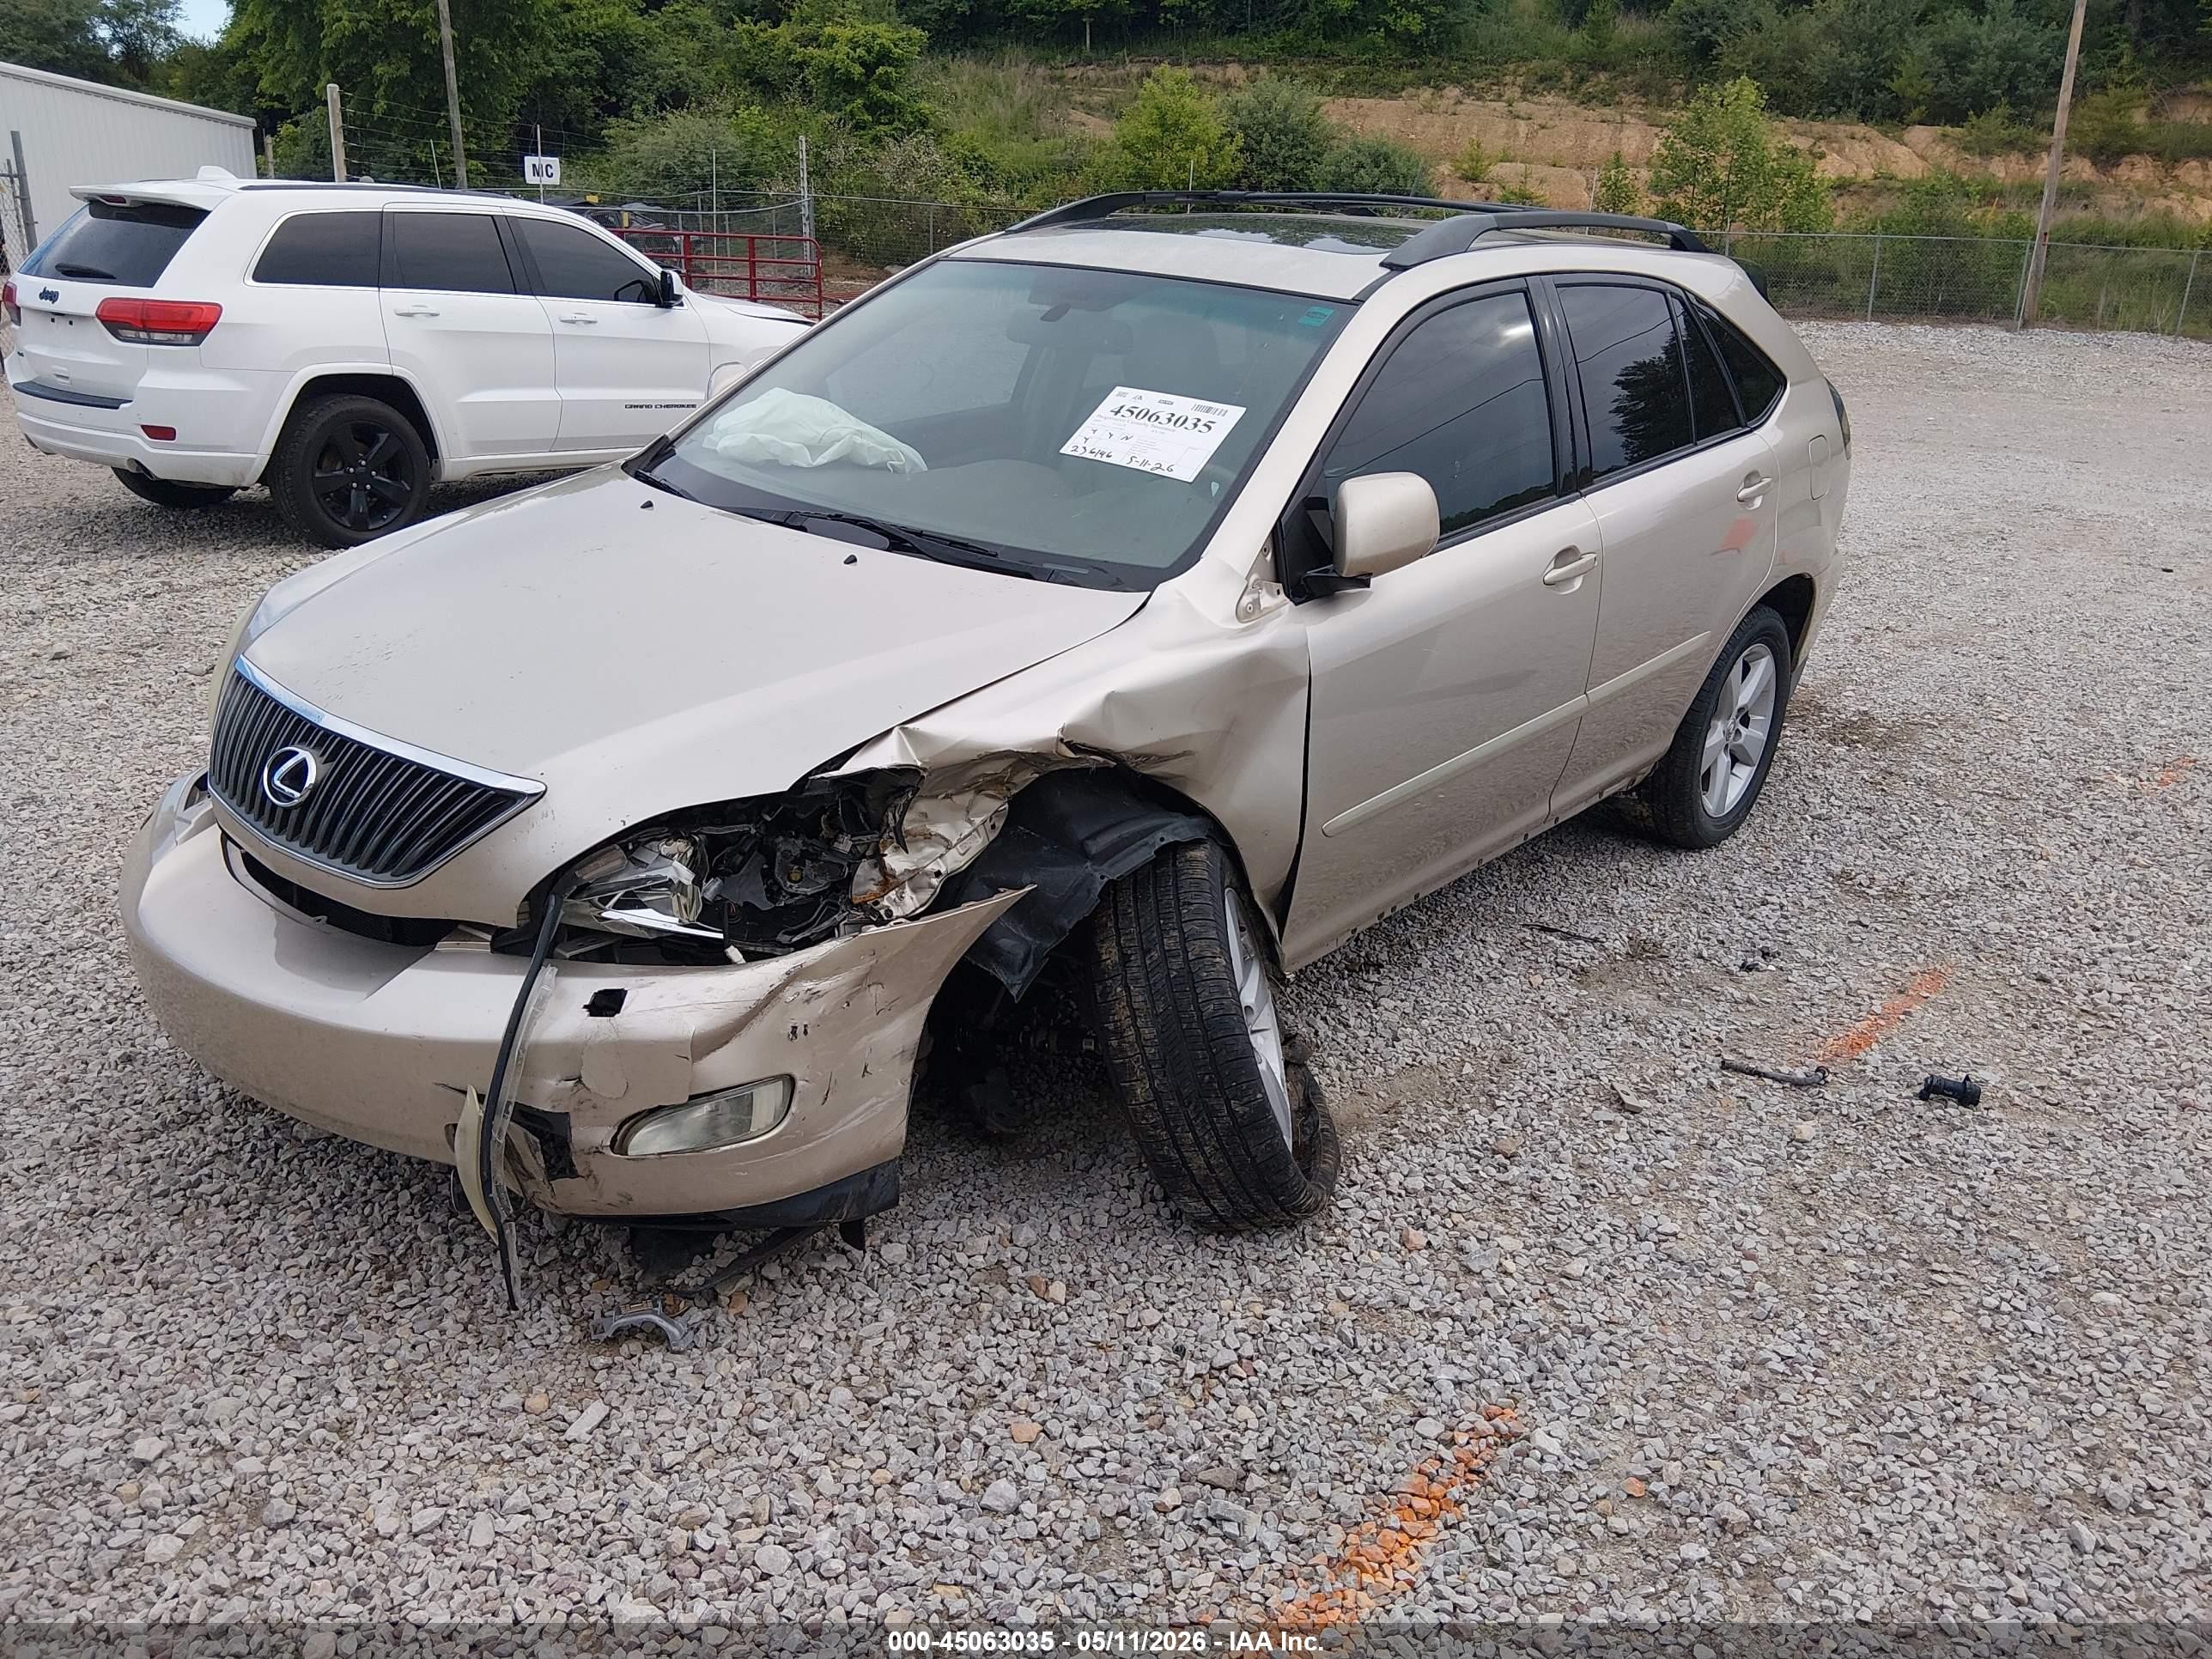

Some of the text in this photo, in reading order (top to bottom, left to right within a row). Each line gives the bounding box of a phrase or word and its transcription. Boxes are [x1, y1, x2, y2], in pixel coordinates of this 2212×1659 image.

[532, 163, 554, 179] MC
[39, 286, 59, 304] Jeep
[1109, 404, 1217, 433] 45063035
[1126, 455, 1176, 472] 5-11-26
